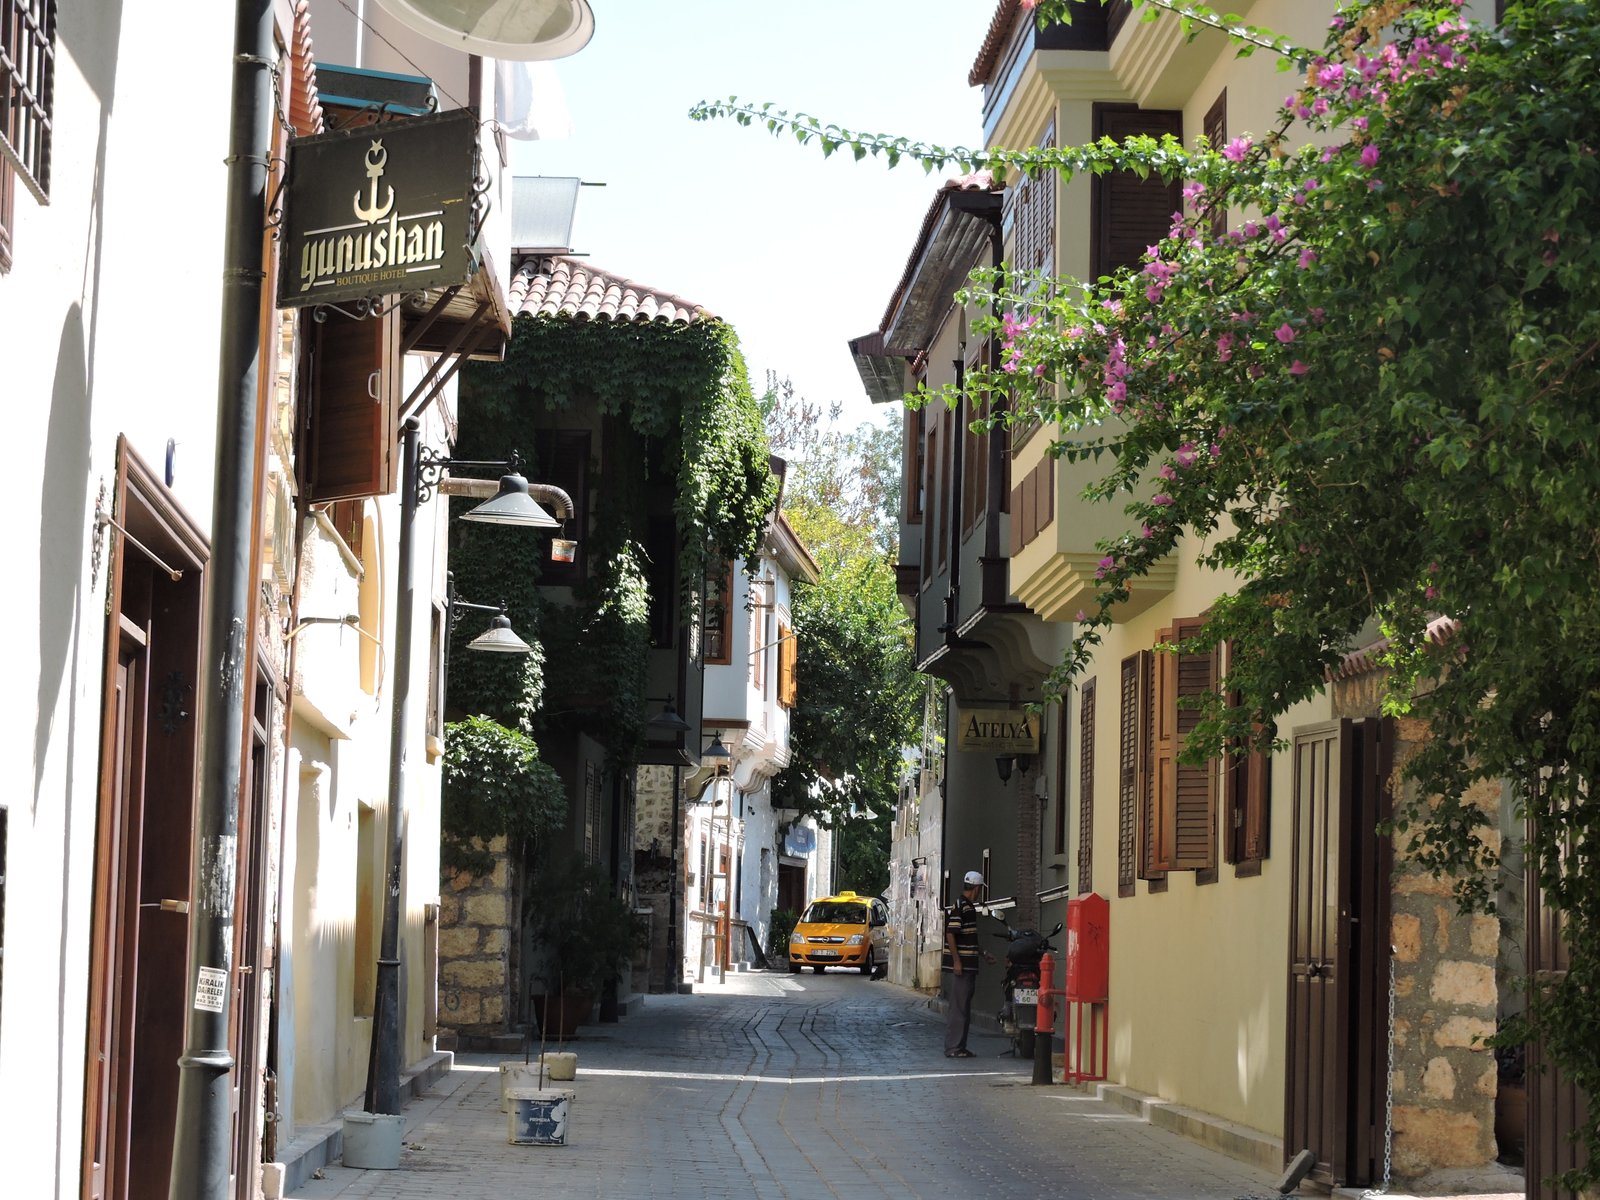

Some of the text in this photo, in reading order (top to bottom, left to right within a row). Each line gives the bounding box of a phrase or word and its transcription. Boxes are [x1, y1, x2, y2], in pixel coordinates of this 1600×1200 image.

[300, 211, 445, 292] yunushan
[336, 269, 407, 286] BOUTIQUE HOTEL
